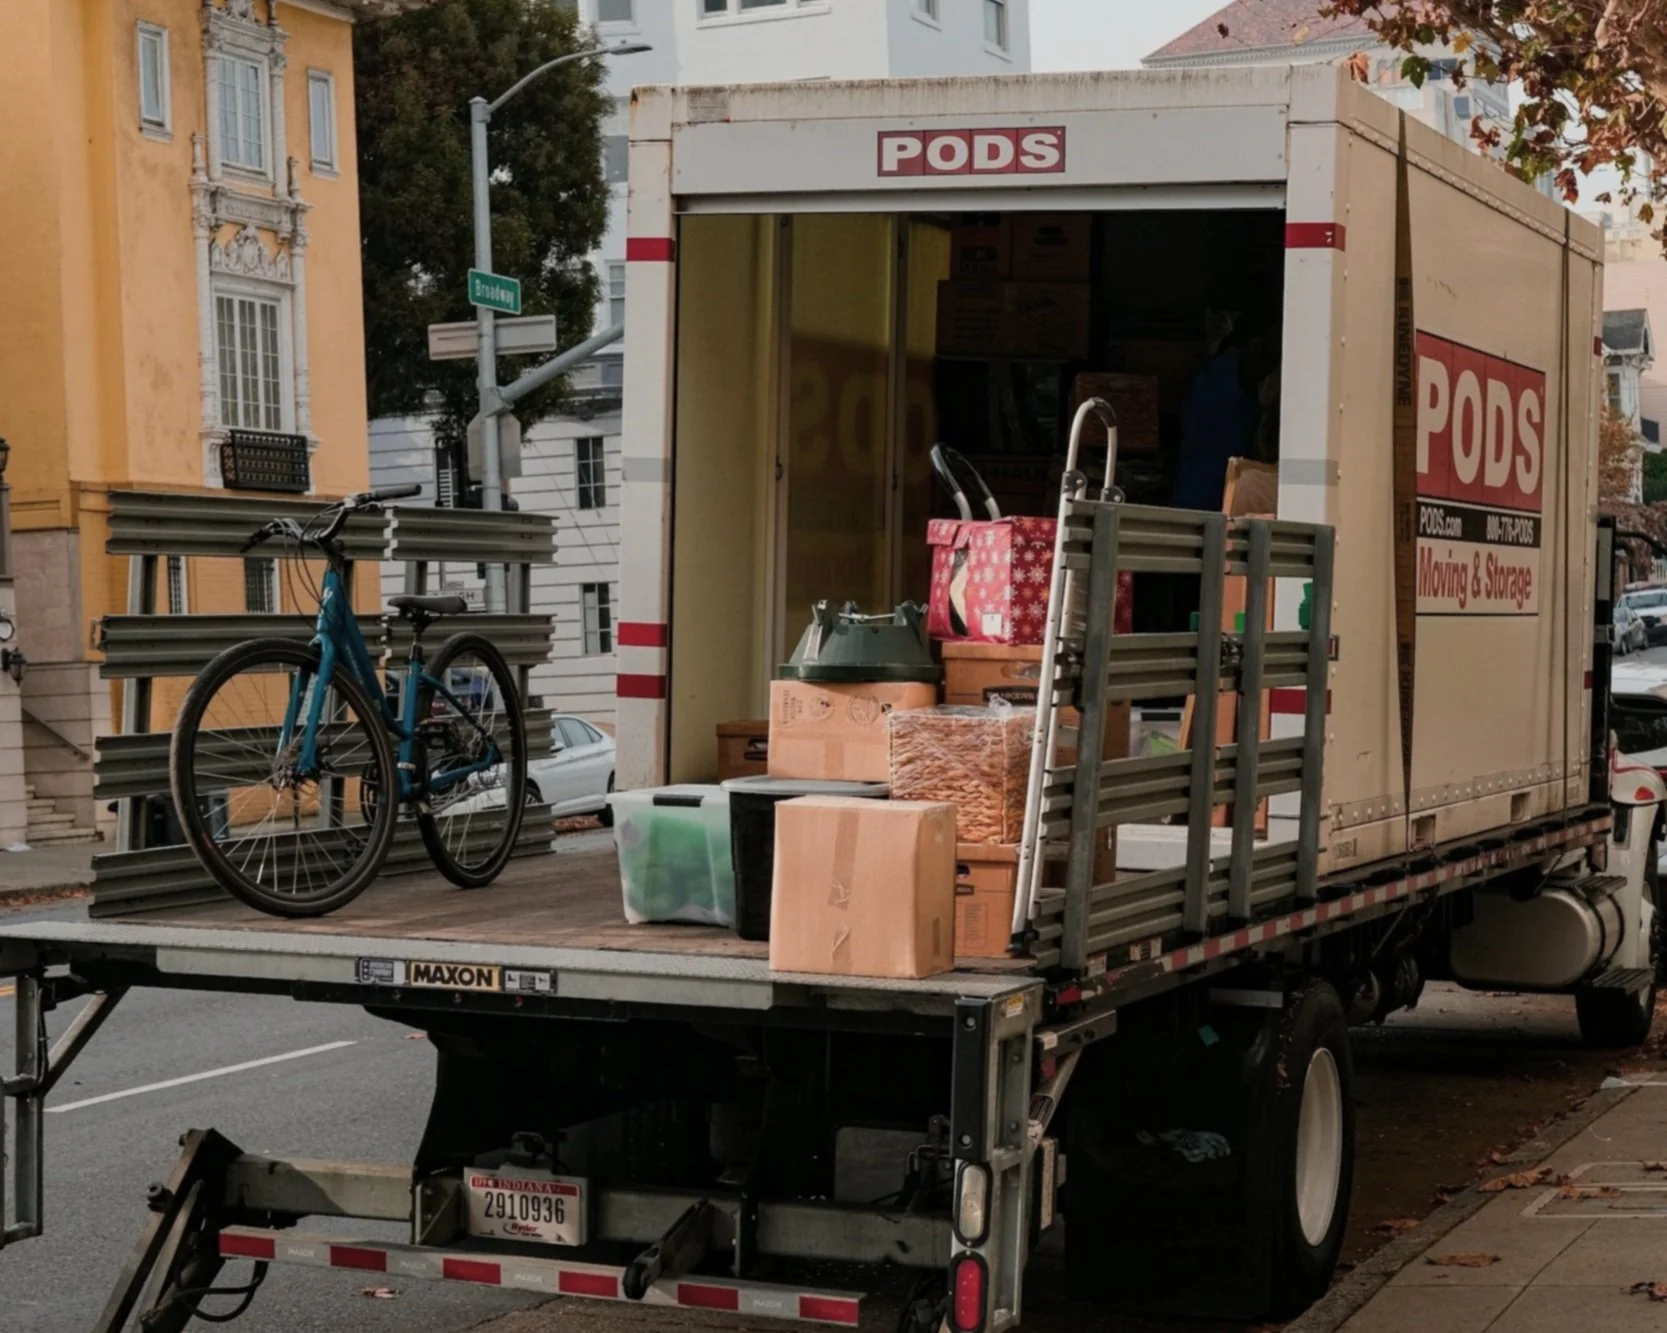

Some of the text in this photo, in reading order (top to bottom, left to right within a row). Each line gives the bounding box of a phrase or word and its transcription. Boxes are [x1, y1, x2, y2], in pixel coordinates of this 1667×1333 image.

[882, 133, 1060, 171] PODS
[475, 279, 514, 309] Broadway
[1416, 355, 1540, 494] PODS
[1420, 506, 1462, 538] PODS.com
[1419, 546, 1532, 610] Moving & Storage
[413, 963, 494, 988] MAXON
[499, 1178, 553, 1194] INDIANA
[484, 1191, 565, 1224] 2910936
